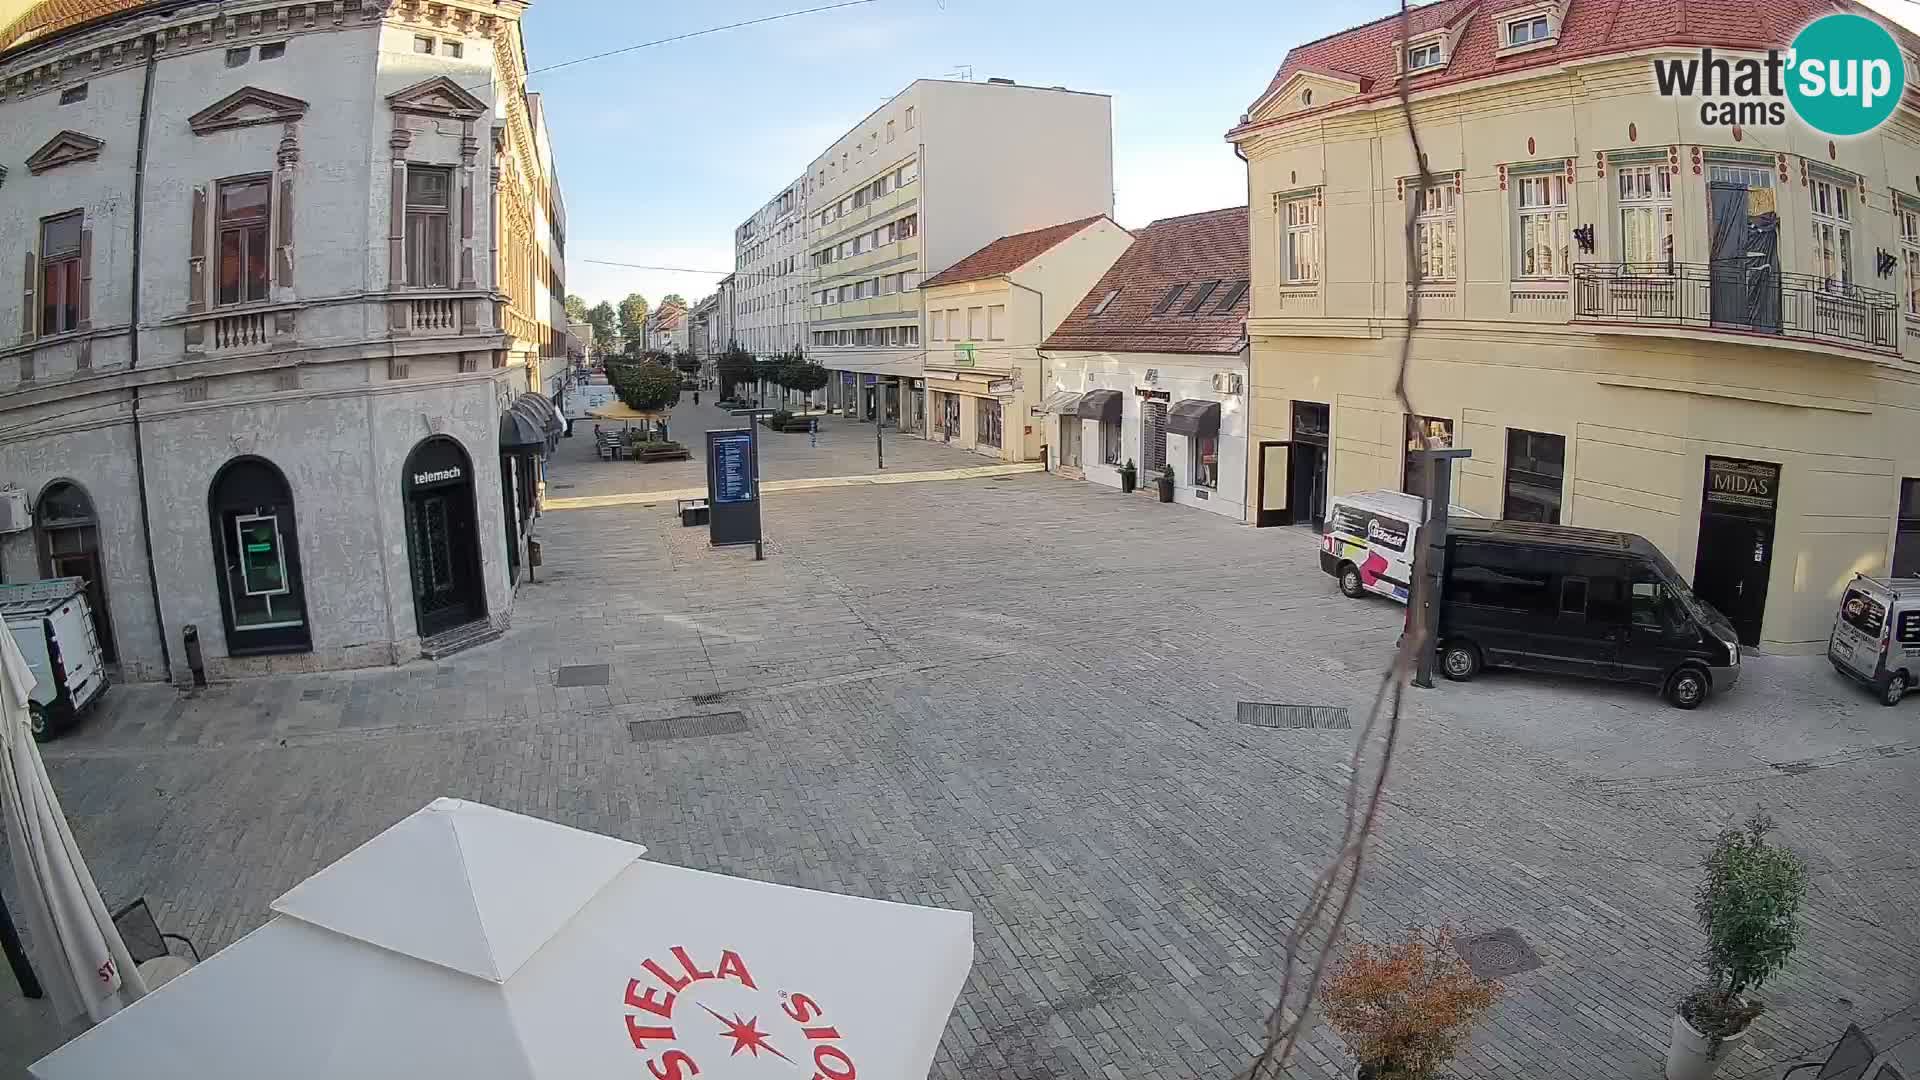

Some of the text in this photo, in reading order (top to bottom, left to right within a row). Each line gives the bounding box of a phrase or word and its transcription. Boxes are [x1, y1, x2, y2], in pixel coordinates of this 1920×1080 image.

[414, 466, 461, 485] telemach
[1713, 473, 1768, 495] MIDAS
[623, 945, 759, 1080] STELLA
[781, 991, 857, 1080] OIS
